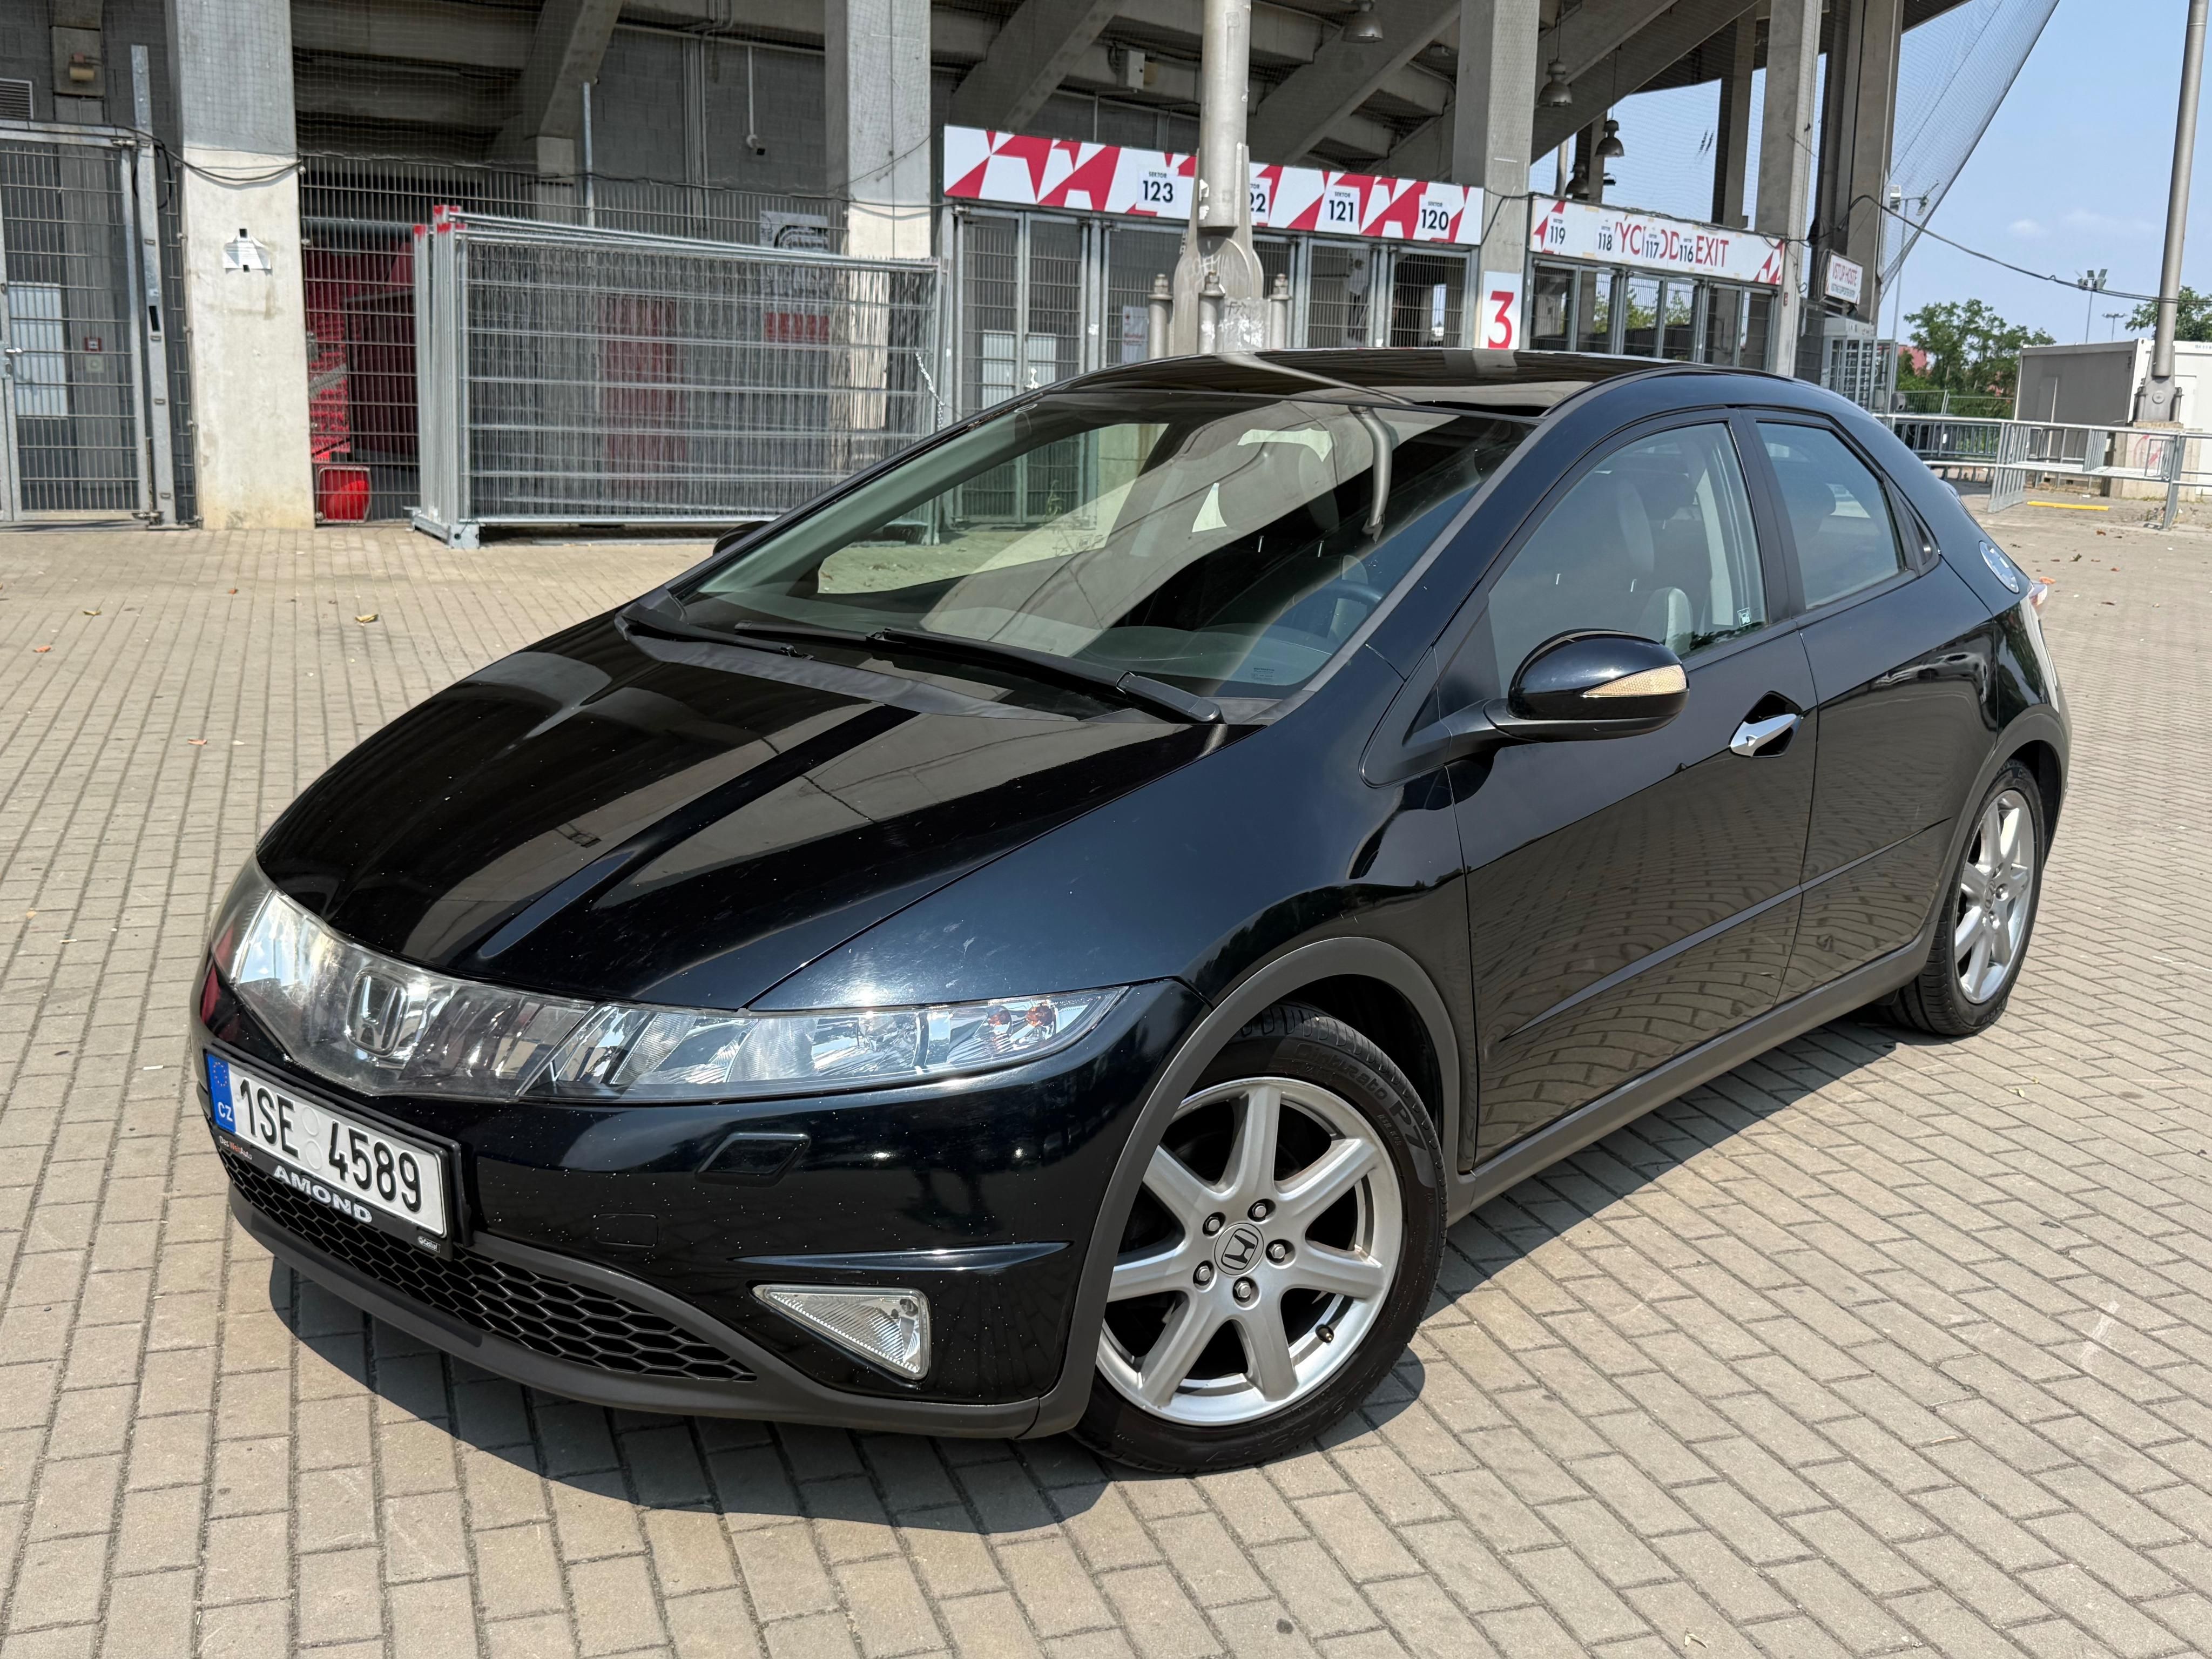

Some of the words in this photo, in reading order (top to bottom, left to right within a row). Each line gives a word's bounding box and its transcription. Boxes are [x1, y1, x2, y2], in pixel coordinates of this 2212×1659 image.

[1143, 180, 1174, 203] 123
[1329, 200, 1354, 222] 121
[1421, 209, 1449, 231] 120
[1550, 226, 1566, 245] 119
[1598, 233, 1613, 251] 118
[1646, 240, 1660, 259] 117
[1680, 245, 1694, 263] 116
[1695, 235, 1729, 267] EXIT
[1488, 291, 1514, 349] 3
[218, 1101, 233, 1122] CZ
[240, 1077, 300, 1159] 1SE
[329, 1120, 422, 1213] 4589
[273, 1165, 372, 1223] AMOND
